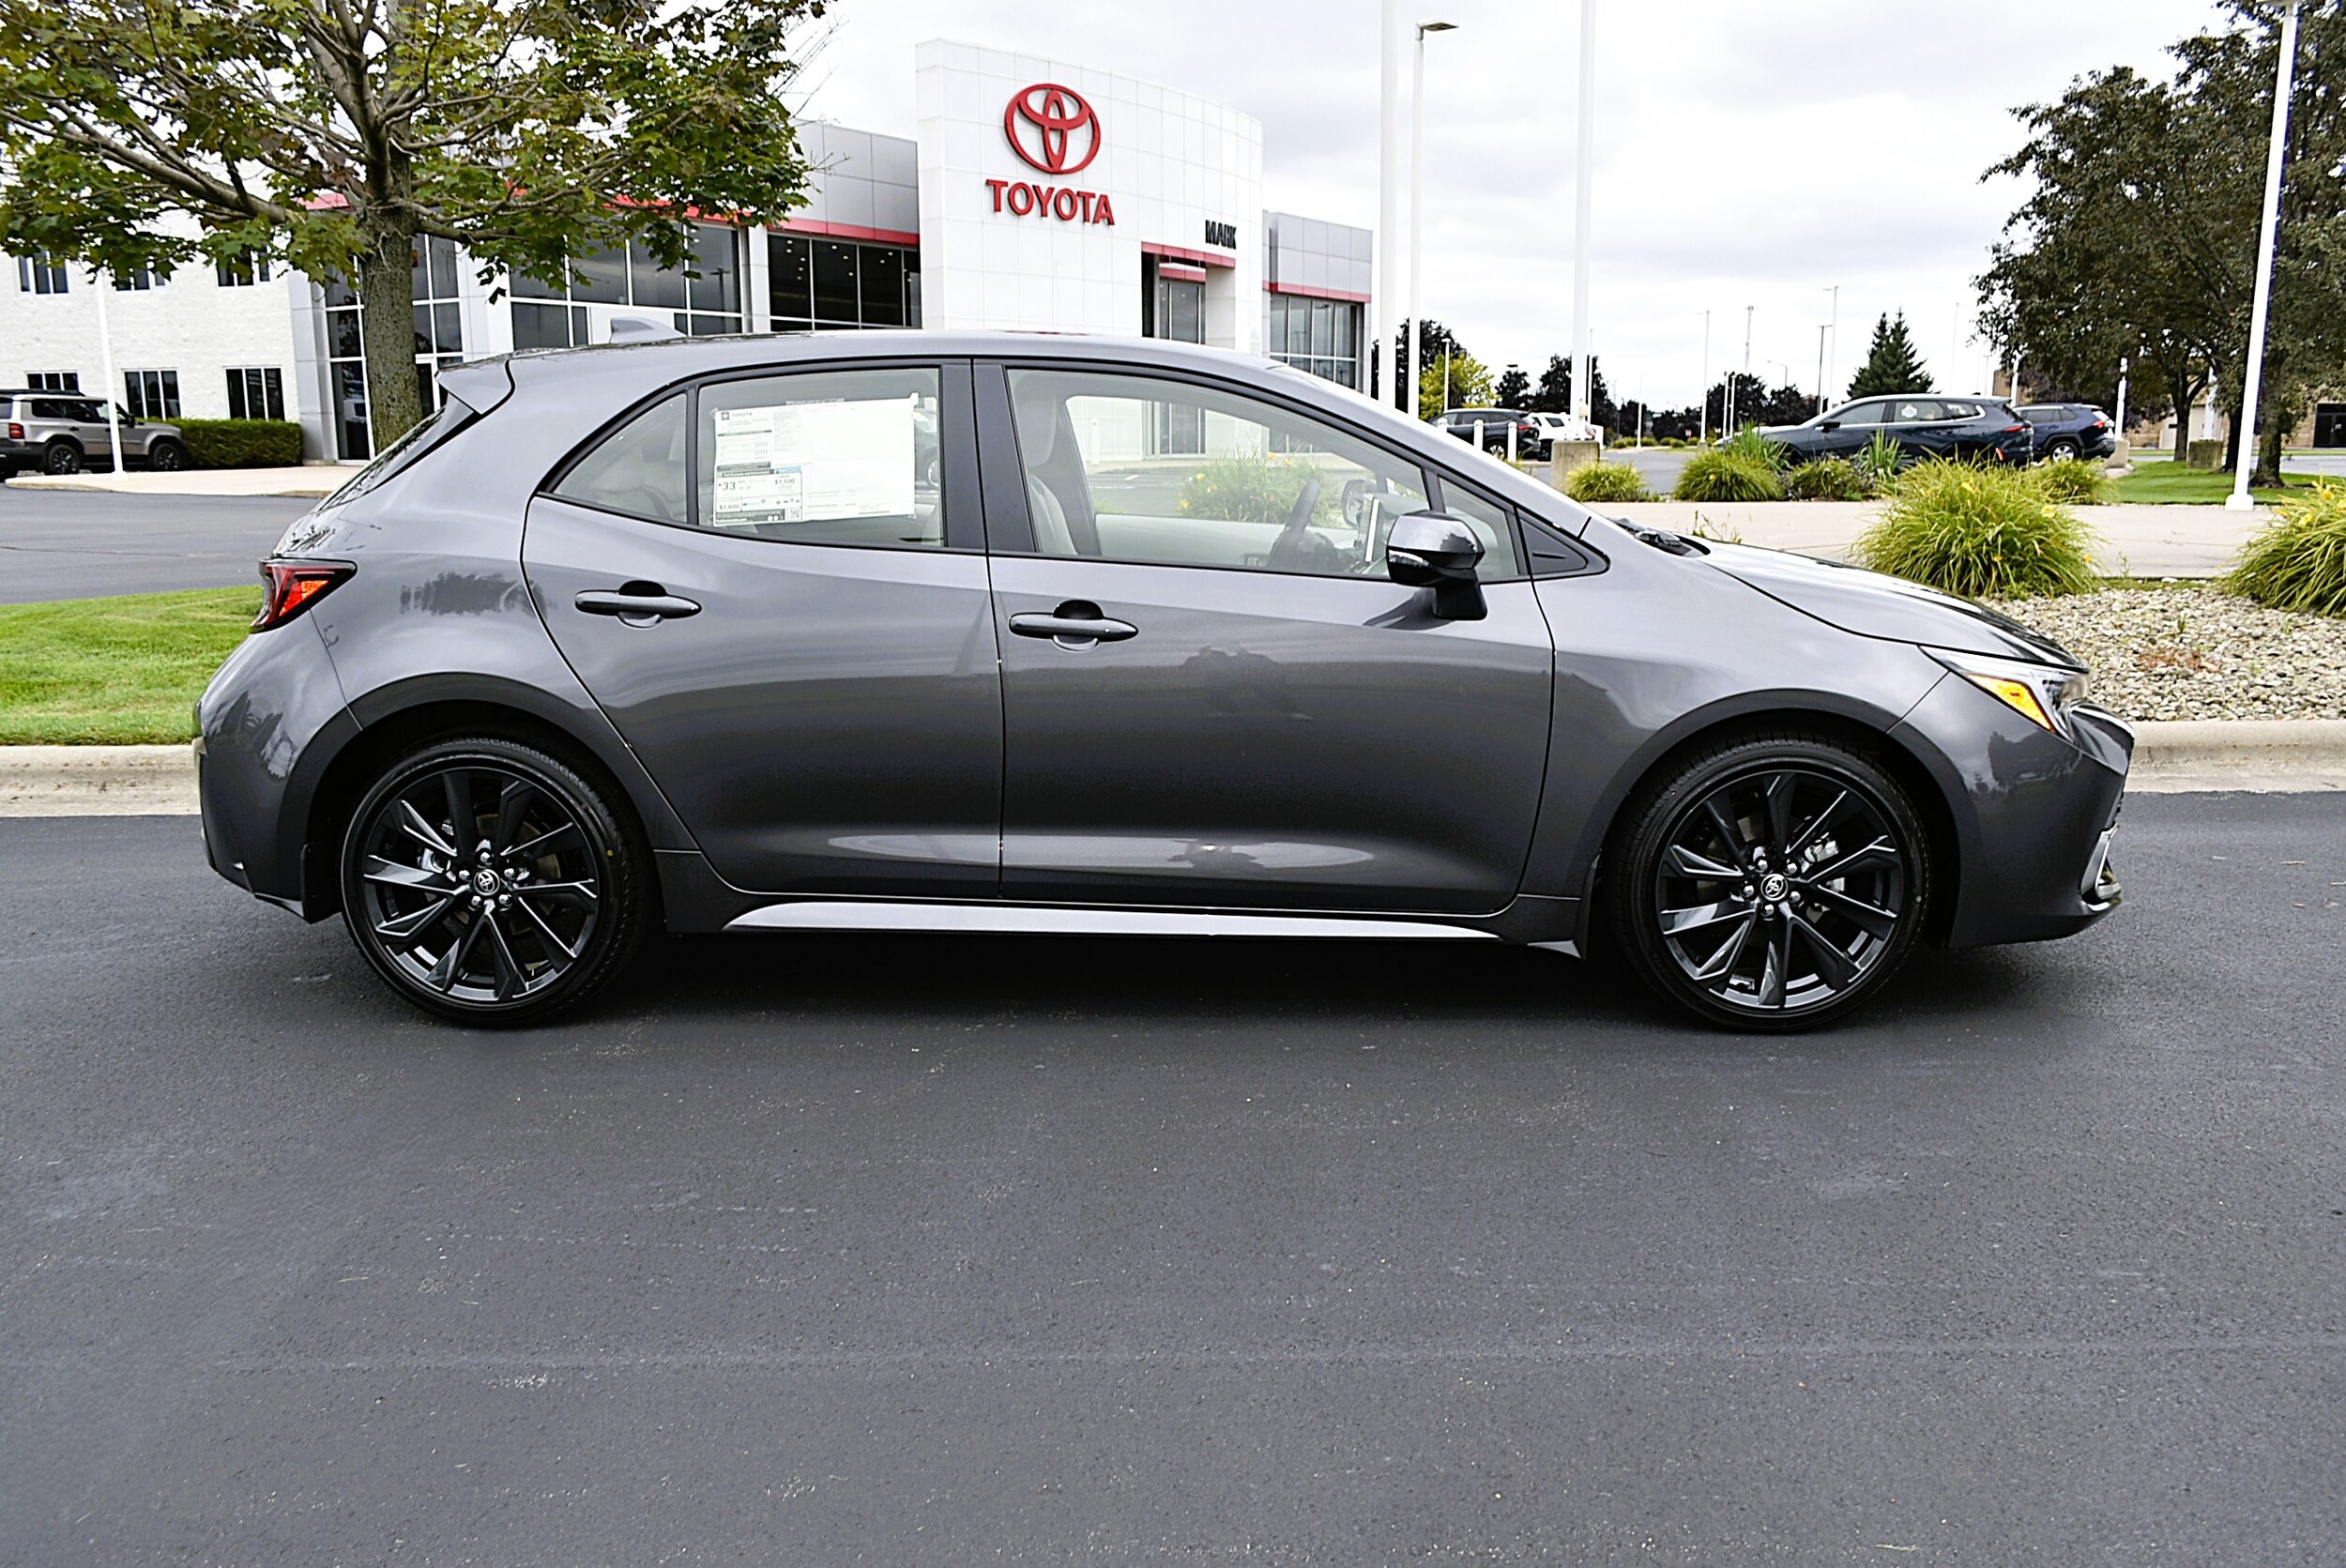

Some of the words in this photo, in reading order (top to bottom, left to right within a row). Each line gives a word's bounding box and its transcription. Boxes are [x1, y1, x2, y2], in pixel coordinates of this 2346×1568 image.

[985, 178, 1115, 226] TOYOTA
[1205, 220, 1237, 250] MARK
[722, 481, 736, 491] 33
